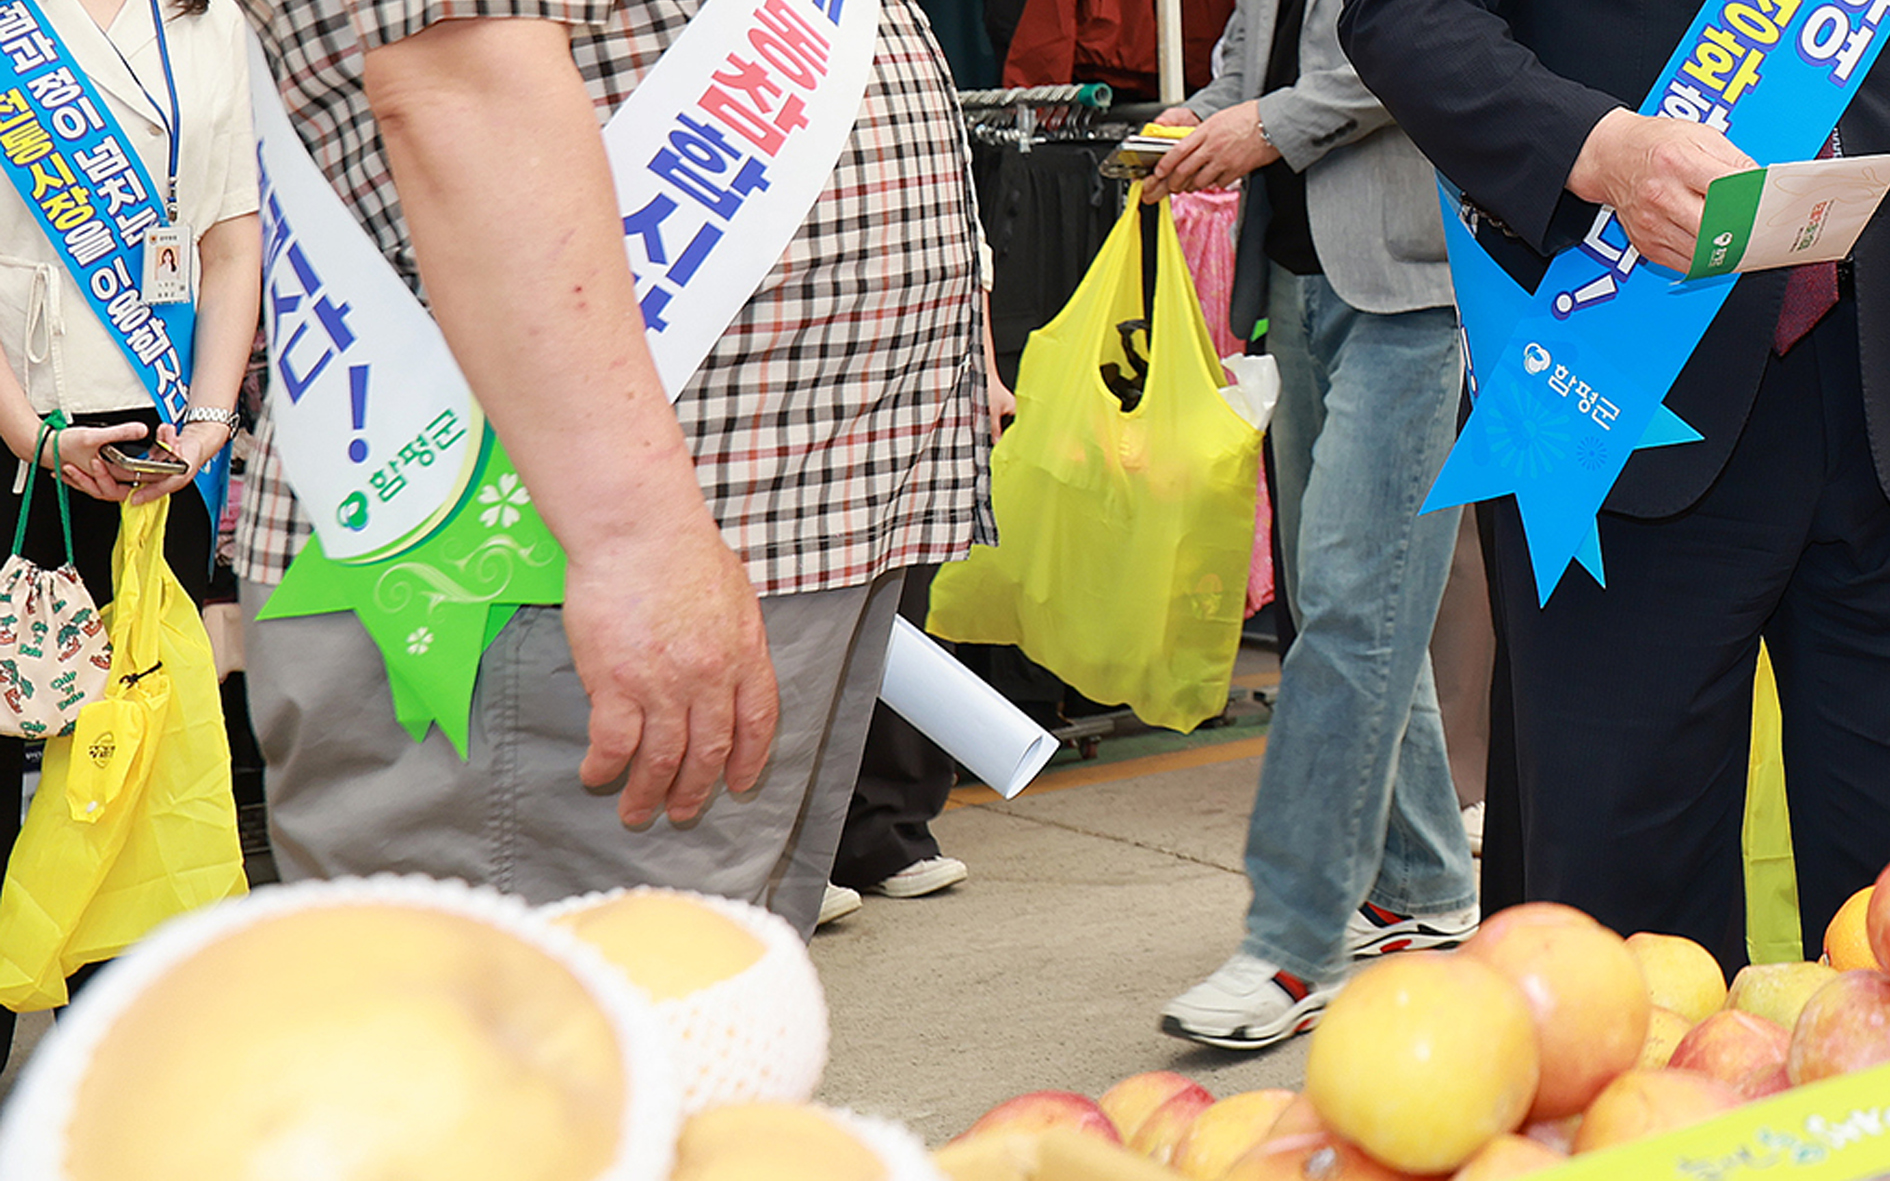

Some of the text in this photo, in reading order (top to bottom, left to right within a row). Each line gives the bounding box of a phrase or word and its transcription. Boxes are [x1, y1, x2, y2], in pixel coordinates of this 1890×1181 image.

[26, 66, 102, 141] 정이
[1548, 364, 1621, 430] 함평군
[369, 408, 467, 502] 함평군
